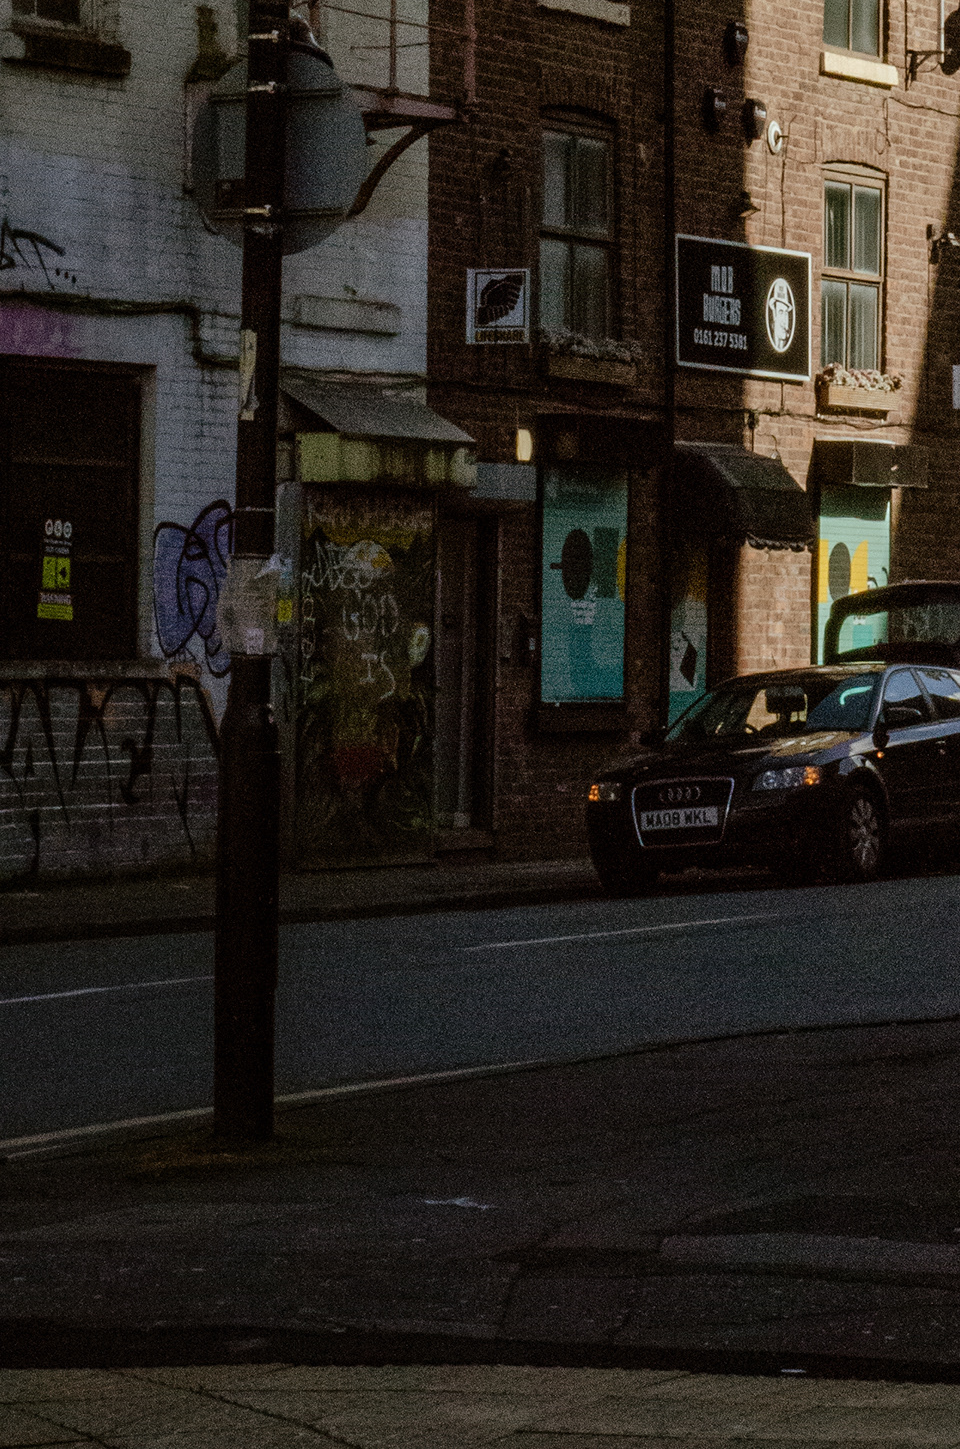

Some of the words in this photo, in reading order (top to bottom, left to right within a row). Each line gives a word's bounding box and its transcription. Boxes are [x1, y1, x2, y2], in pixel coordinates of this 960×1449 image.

[694, 328, 713, 346] 0161
[714, 331, 728, 347] 237
[684, 809, 712, 826] WKL
